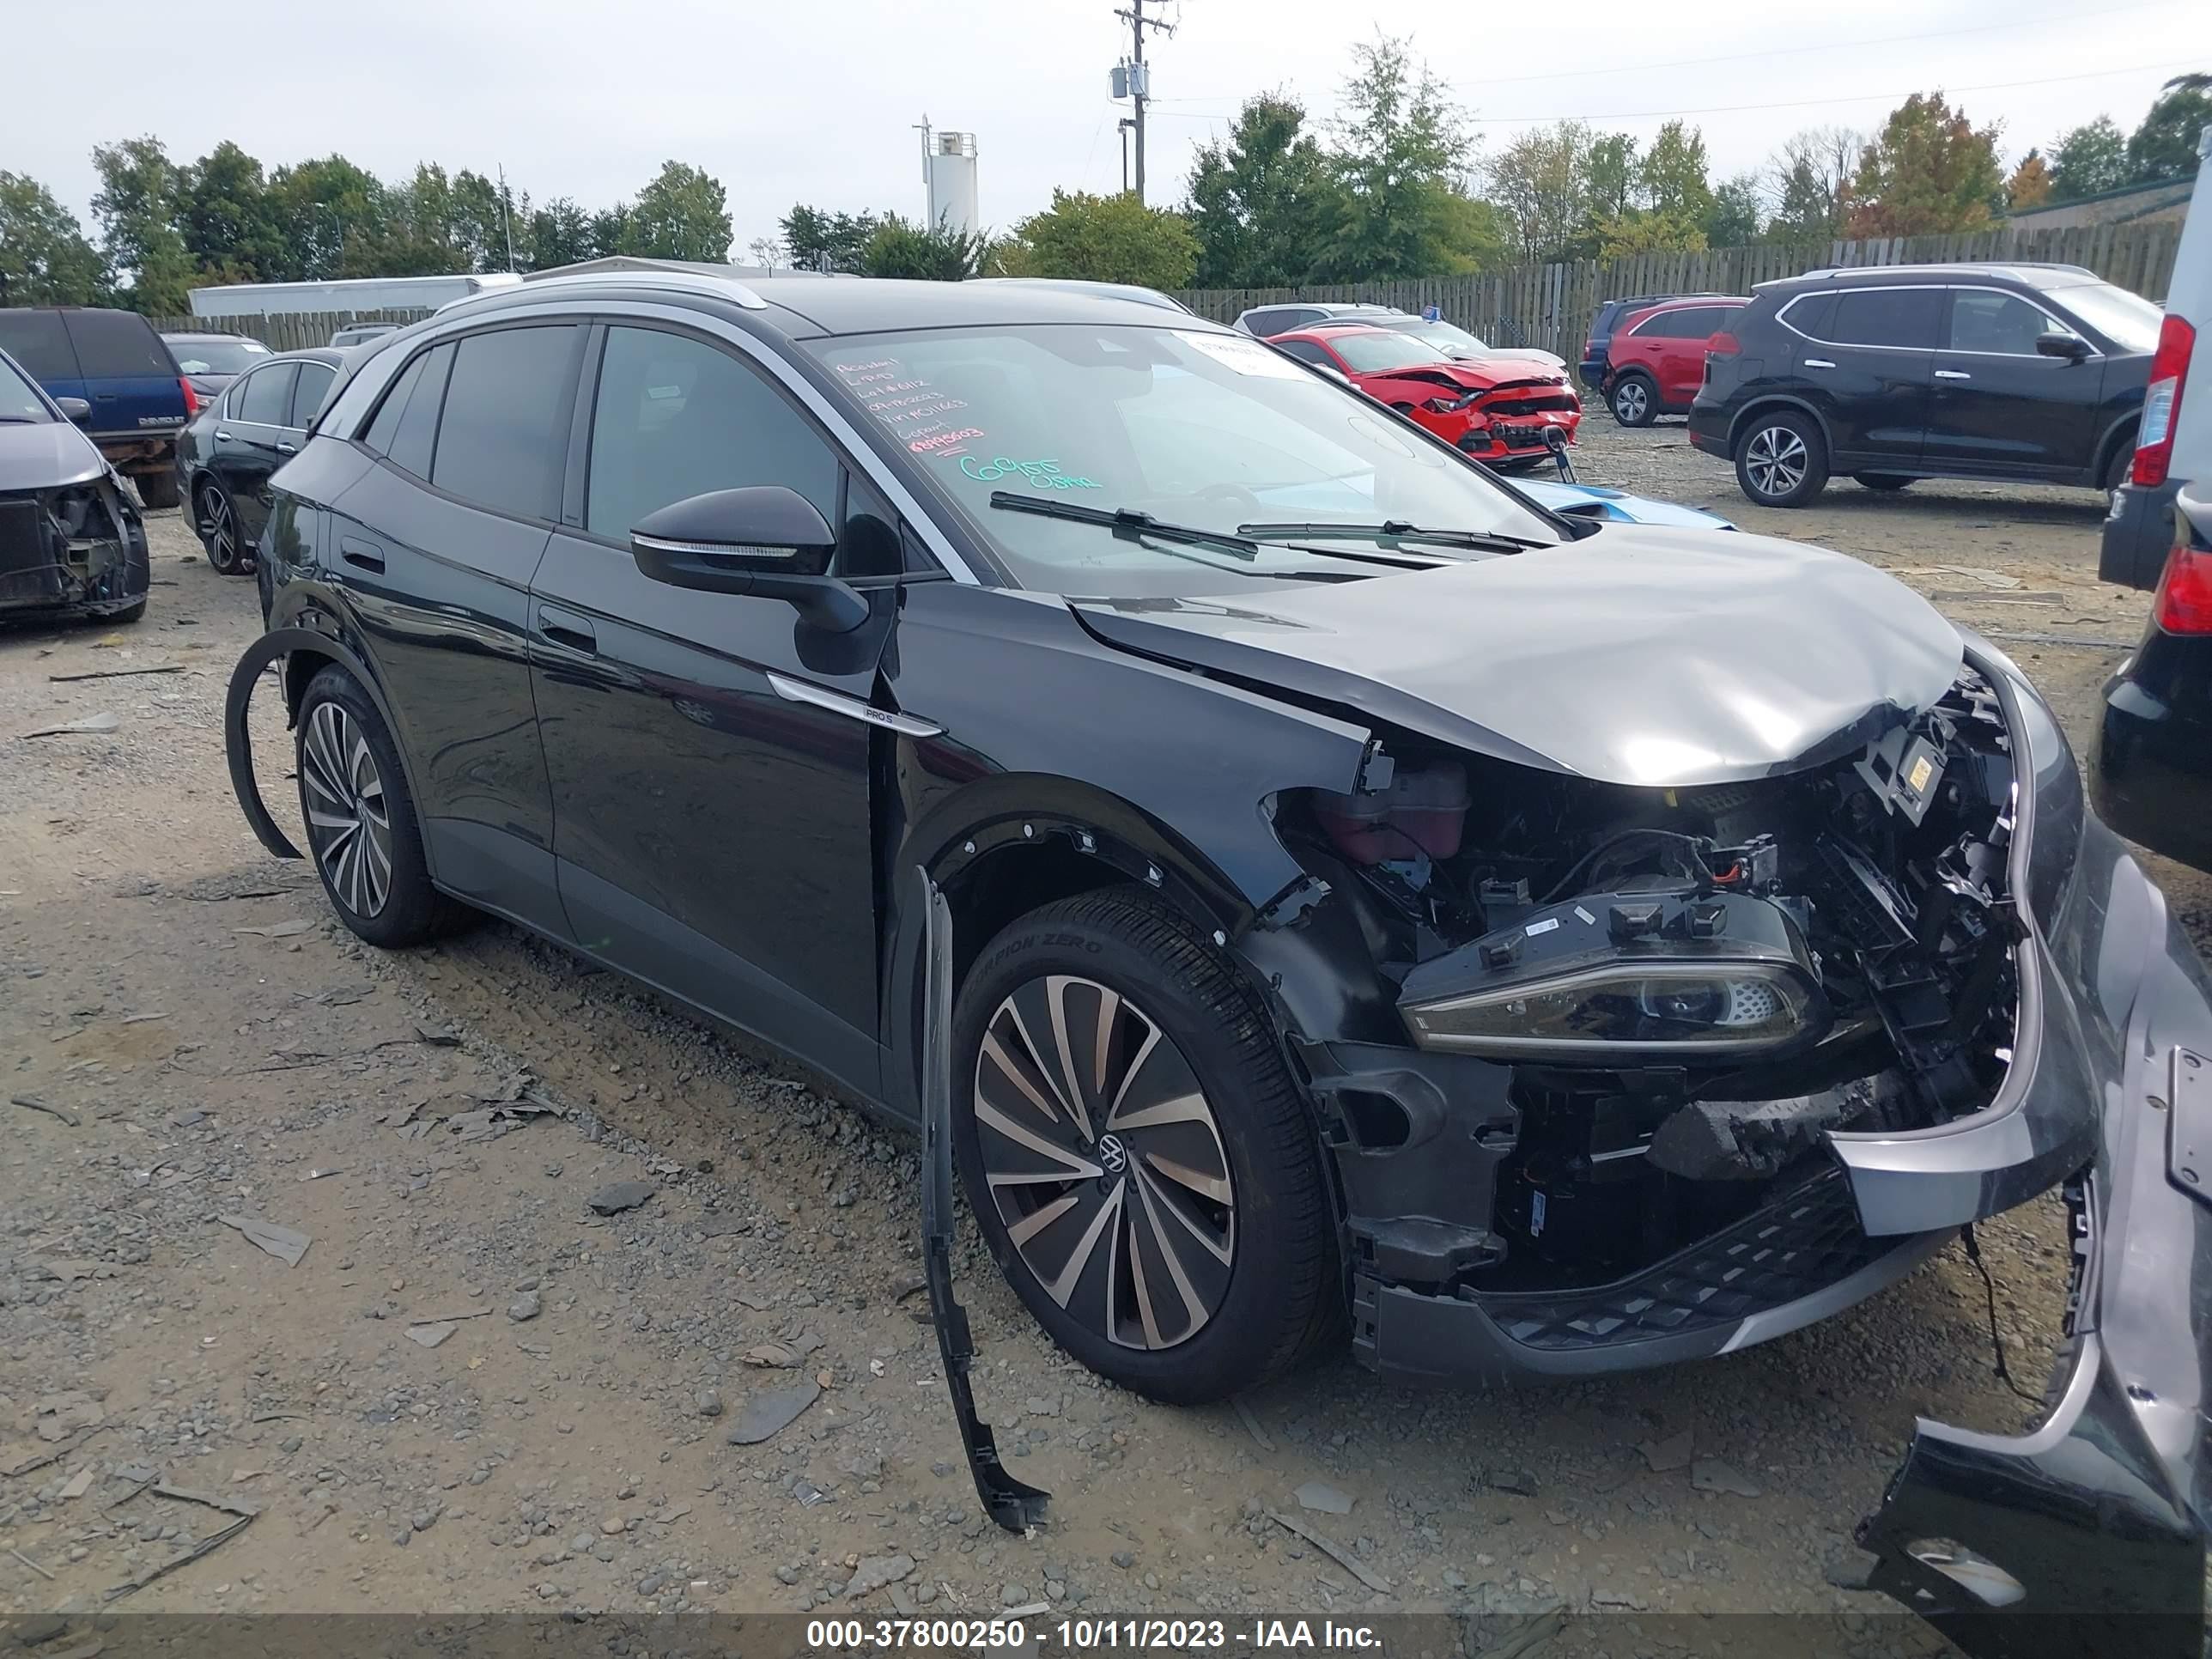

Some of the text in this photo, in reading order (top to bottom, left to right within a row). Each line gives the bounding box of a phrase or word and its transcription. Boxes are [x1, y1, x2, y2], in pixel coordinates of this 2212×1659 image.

[866, 708, 893, 723] PRO S
[1042, 933, 1103, 954] ZERO
